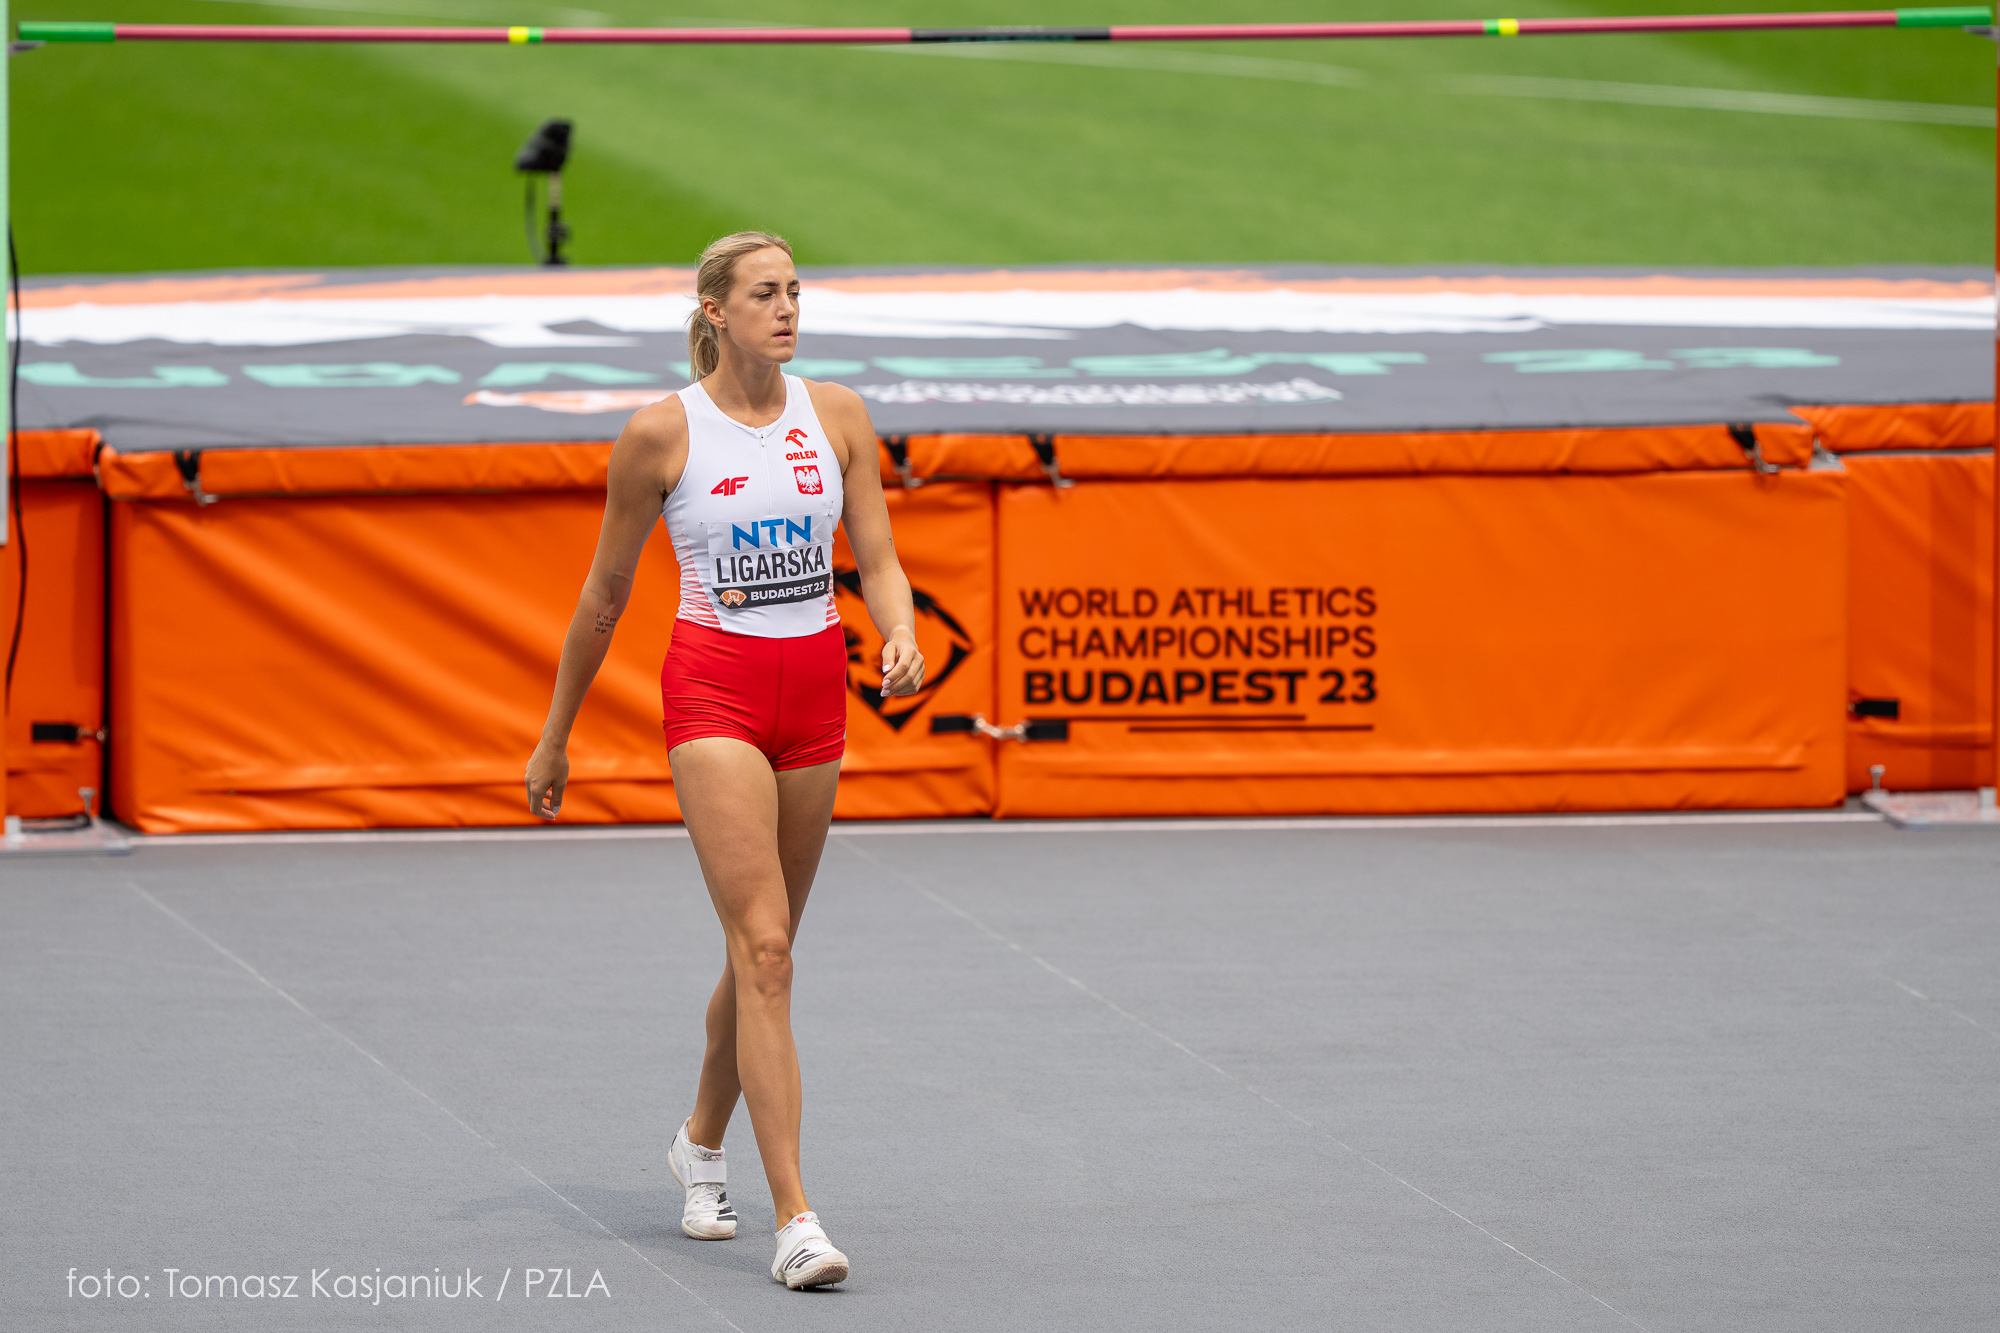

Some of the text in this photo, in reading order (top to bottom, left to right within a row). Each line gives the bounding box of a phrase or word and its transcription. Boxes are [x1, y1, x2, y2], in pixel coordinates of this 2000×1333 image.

[785, 450, 818, 461] ORLEN
[731, 515, 812, 551] NTN
[716, 545, 826, 583] LIGARSKA
[750, 581, 825, 601] BUDAPEST 23
[1019, 587, 1377, 618] WORLD ATHLETICS
[1018, 625, 1377, 660] CHAMPIONSHIPS
[1023, 668, 1377, 705] BUDAPEST 23
